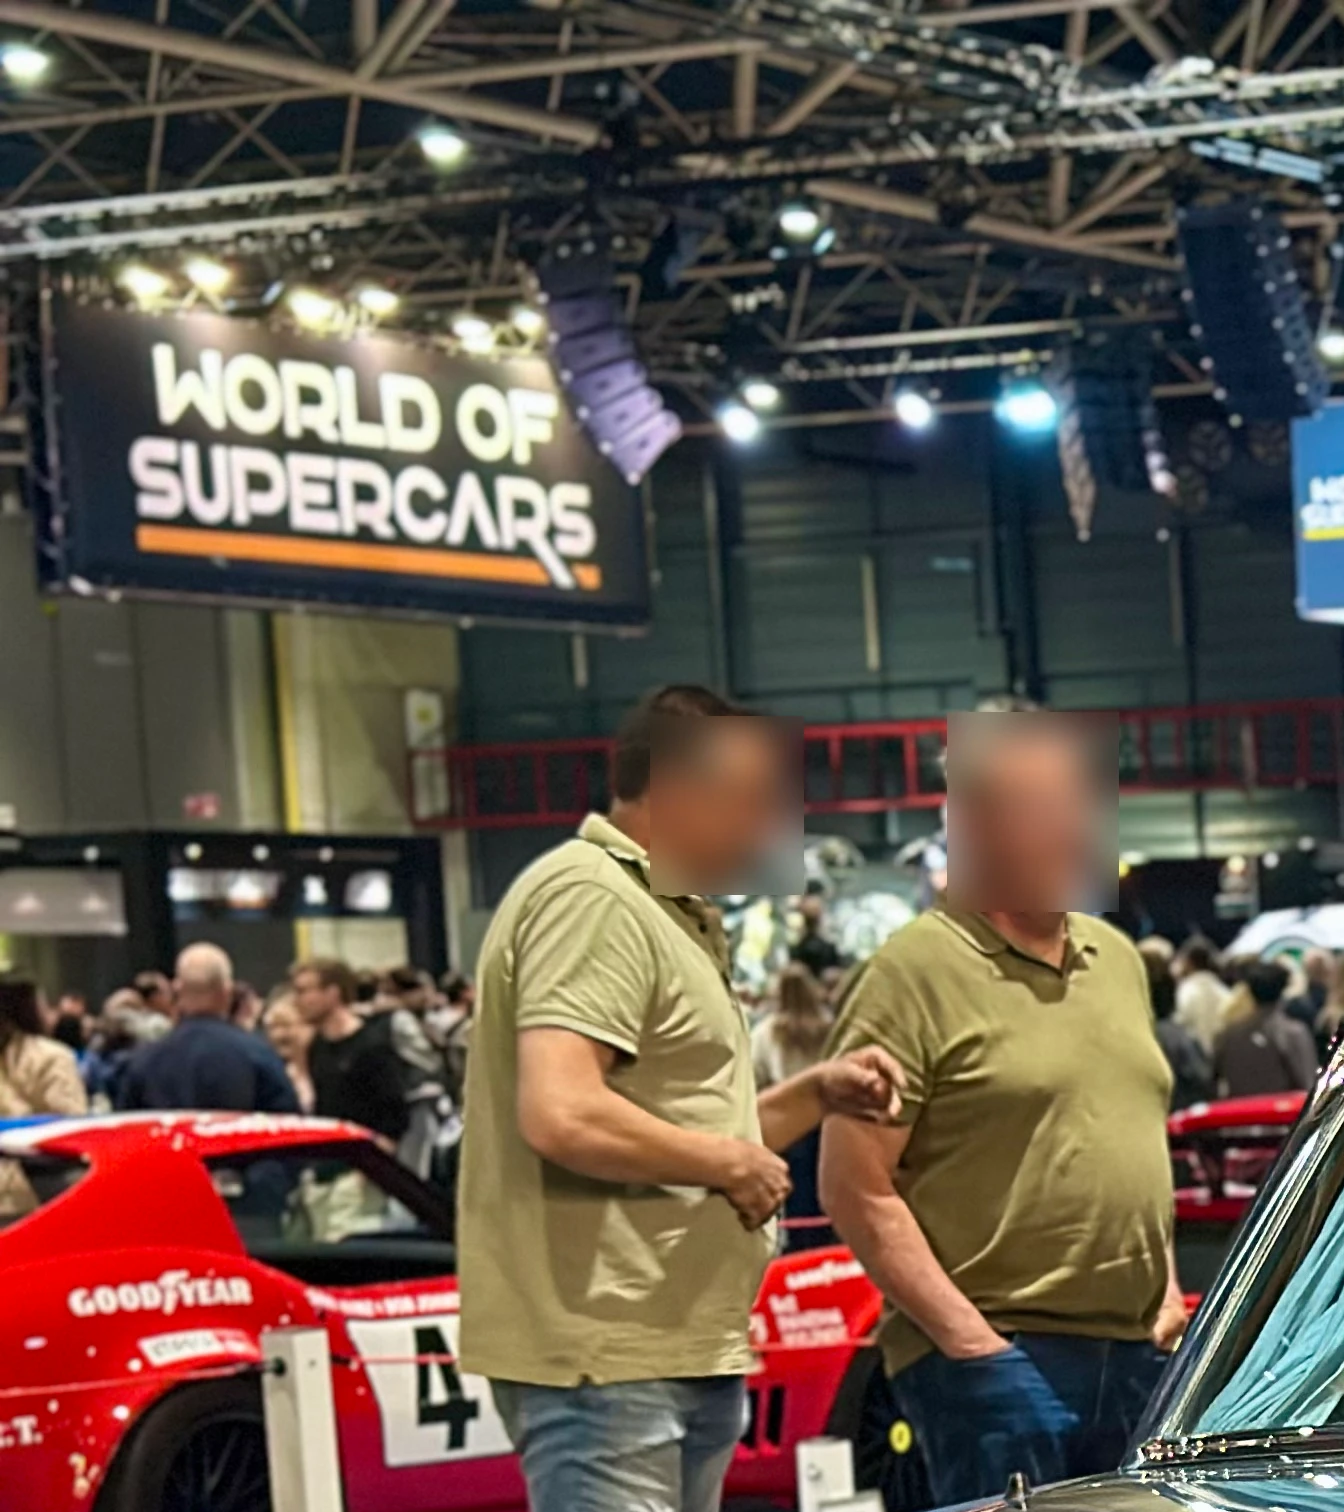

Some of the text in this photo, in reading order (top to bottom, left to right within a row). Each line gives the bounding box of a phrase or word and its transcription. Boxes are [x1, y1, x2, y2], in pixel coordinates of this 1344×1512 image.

[151, 343, 558, 466] WORLD OF
[129, 437, 596, 588] SUPERCARS
[67, 1268, 254, 1318] GOODYEAR
[413, 1325, 480, 1451] 4
